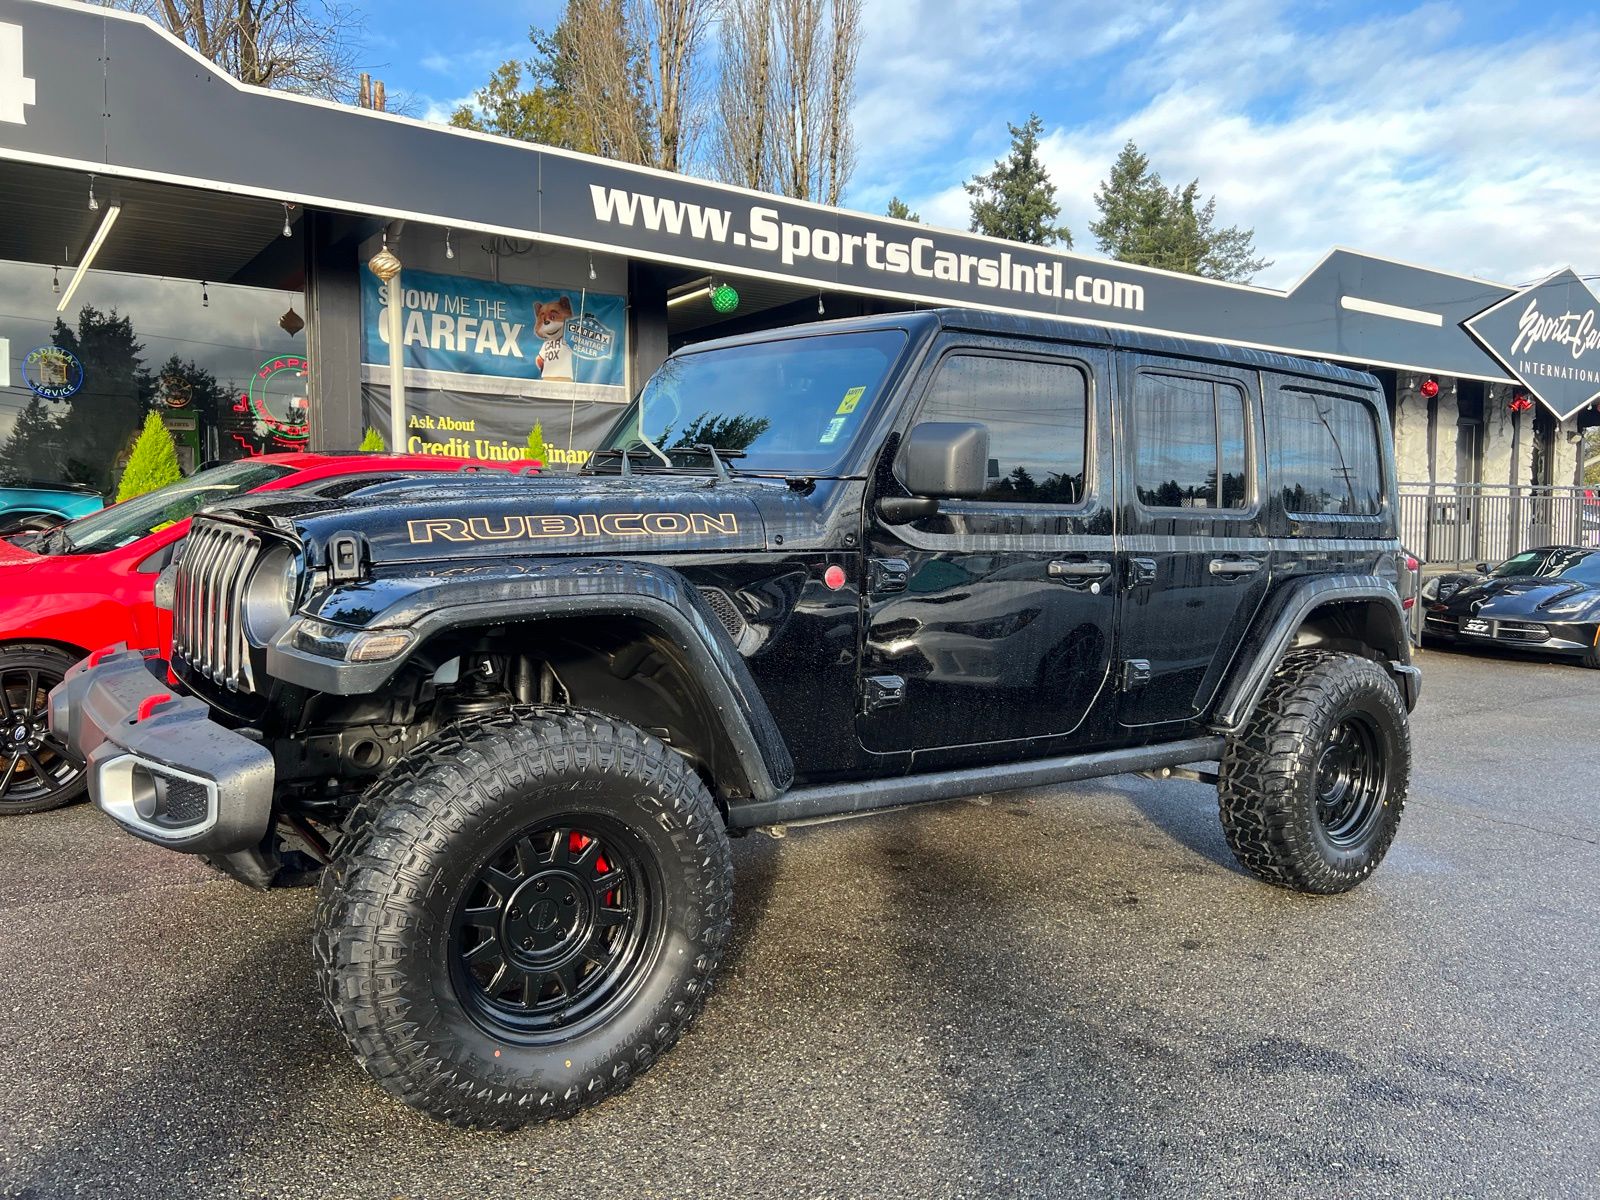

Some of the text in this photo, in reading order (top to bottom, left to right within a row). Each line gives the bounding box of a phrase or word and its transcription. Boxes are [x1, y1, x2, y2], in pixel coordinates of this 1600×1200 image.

[589, 184, 1146, 312] www.SportsCarsIntl.com
[444, 294, 471, 316] ME
[475, 298, 506, 321] THE
[569, 324, 611, 343] CARFAX
[545, 339, 561, 350] CAR
[570, 334, 607, 352] ADVANTAGE
[573, 343, 598, 357] DEALER
[28, 347, 79, 368] CADILLAC
[545, 350, 560, 361] FOX
[33, 382, 75, 397] SERVICE
[409, 415, 475, 431] Ask About
[407, 436, 471, 459] Credit
[407, 513, 739, 544] RUBICON
